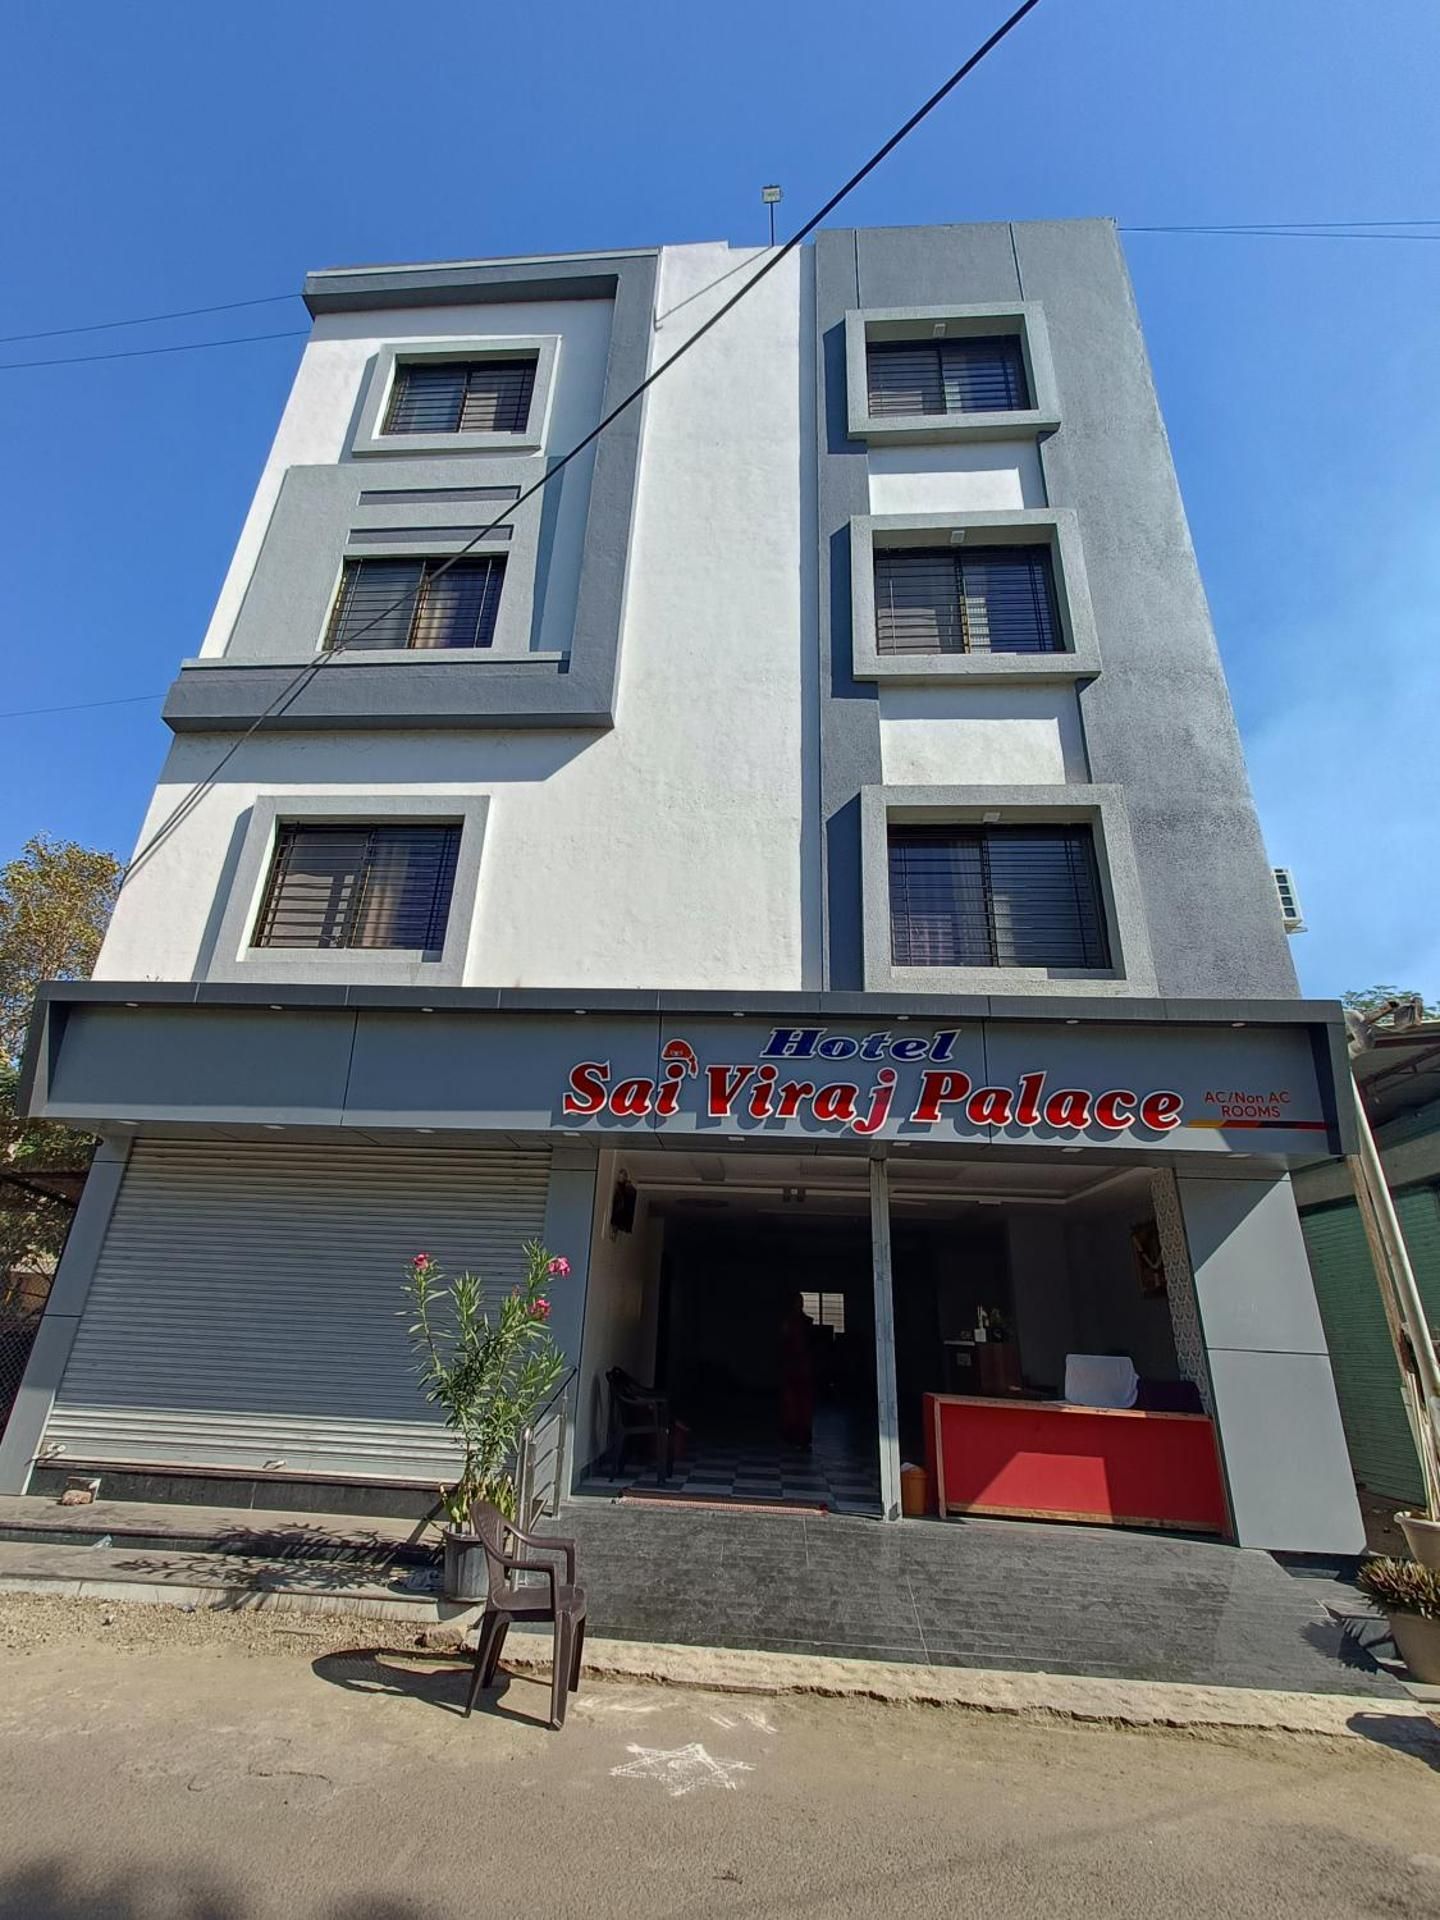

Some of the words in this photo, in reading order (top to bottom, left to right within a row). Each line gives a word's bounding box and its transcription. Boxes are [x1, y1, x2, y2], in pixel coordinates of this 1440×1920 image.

[759, 1027, 961, 1062] Hotel
[563, 1060, 688, 1117] Sai
[704, 1064, 898, 1135] Viraj
[910, 1069, 1182, 1131] Palace
[1204, 1091, 1265, 1103] AC/Non
[1268, 1091, 1291, 1104] AC
[1221, 1105, 1281, 1118] ROOMS
